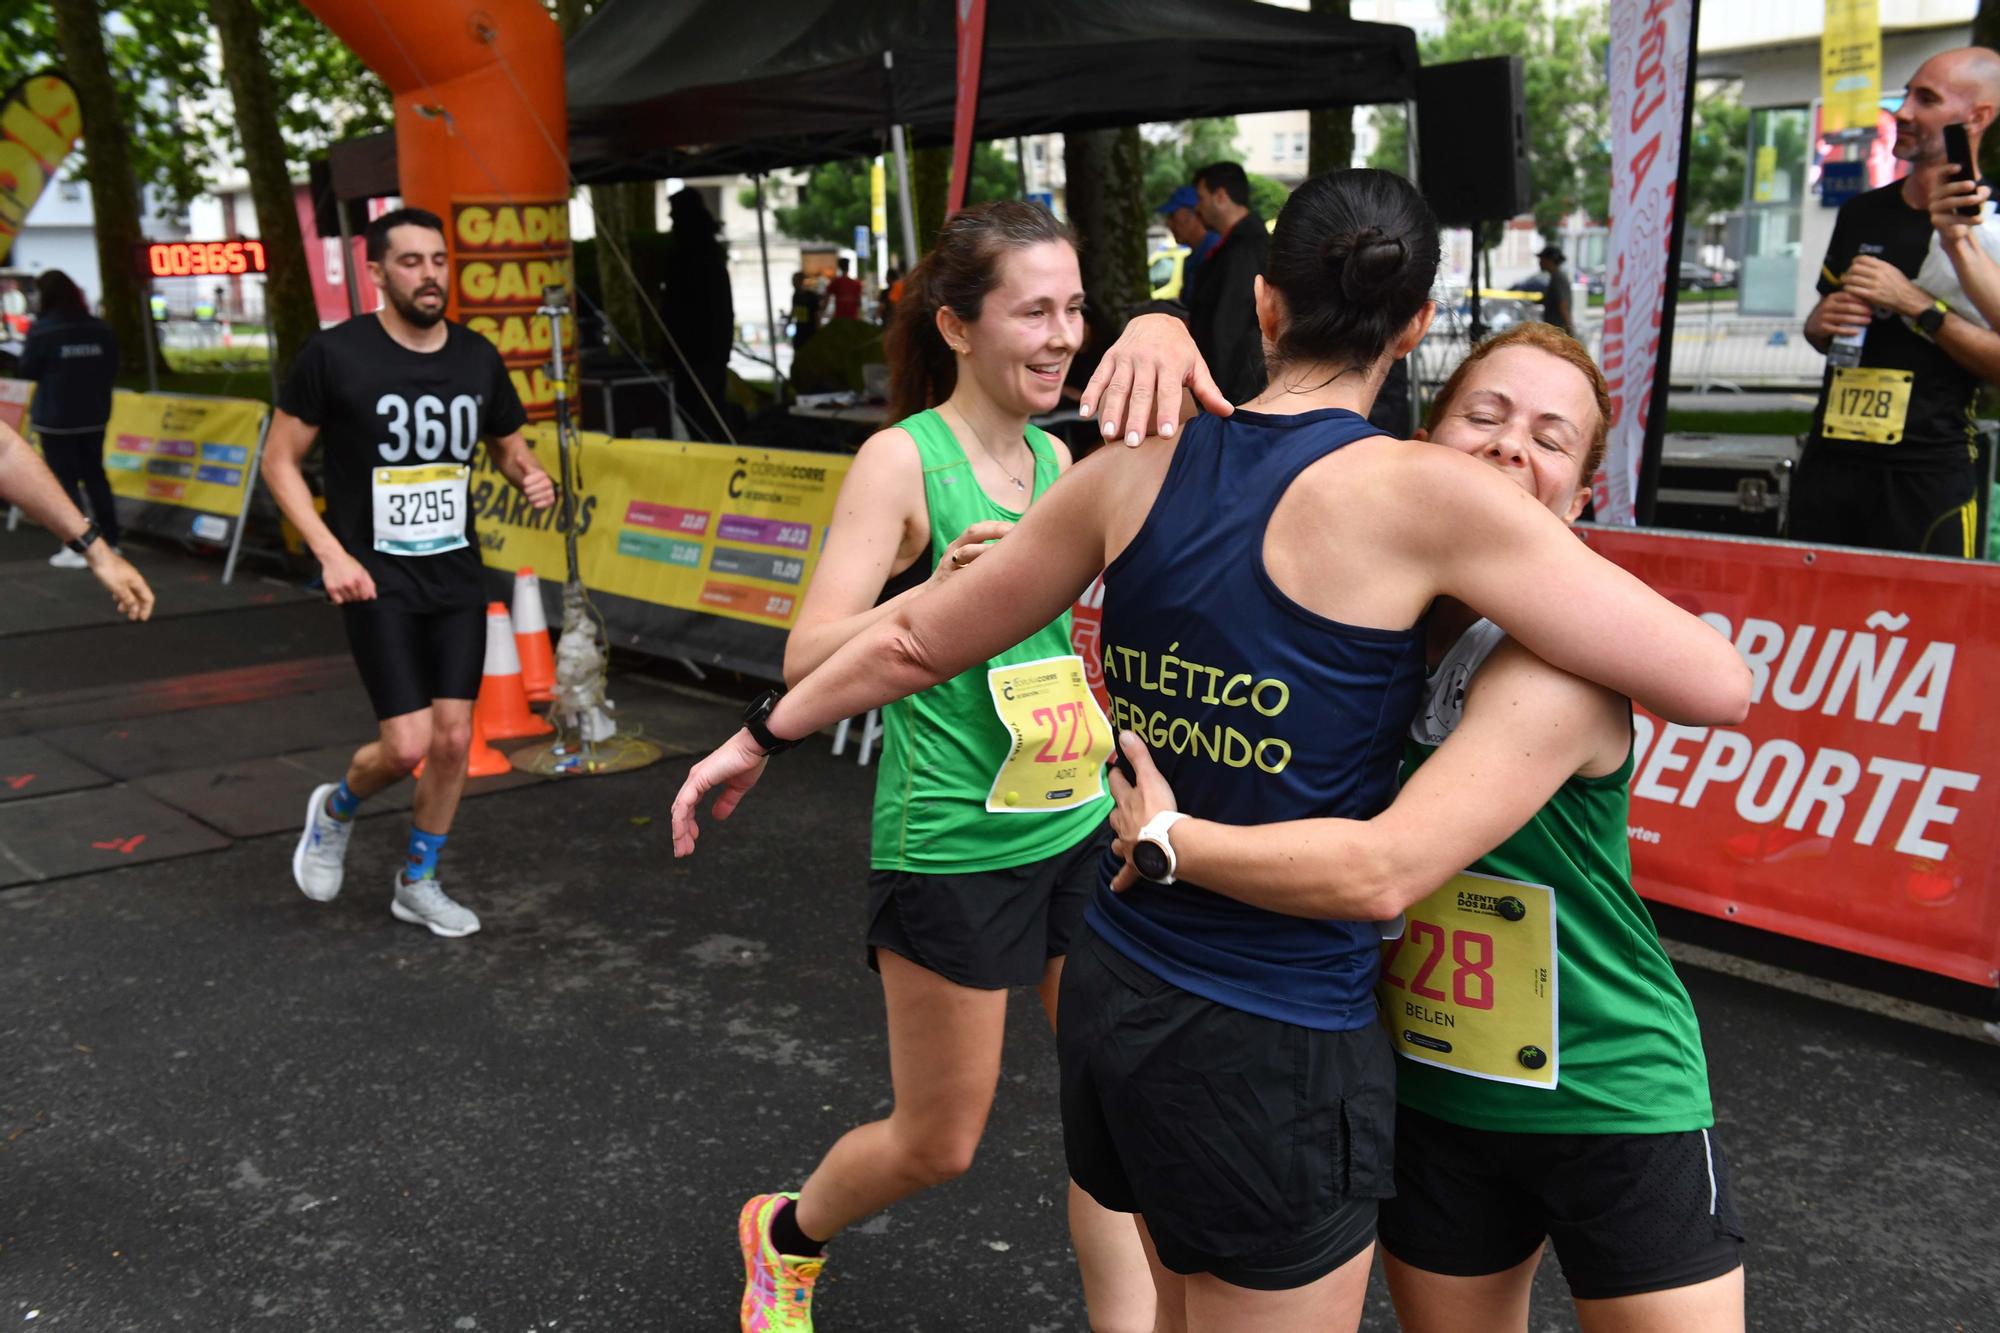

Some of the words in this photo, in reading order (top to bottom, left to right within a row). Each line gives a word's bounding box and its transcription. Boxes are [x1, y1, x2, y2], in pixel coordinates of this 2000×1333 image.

[1839, 387, 1893, 419] 1728
[389, 488, 455, 526] 3295
[1104, 641, 1290, 717] ATLÉTICO
[1697, 610, 1955, 732] RUÑA
[1107, 692, 1292, 774] BERGONDO
[1405, 1002, 1456, 1028] BELEN
